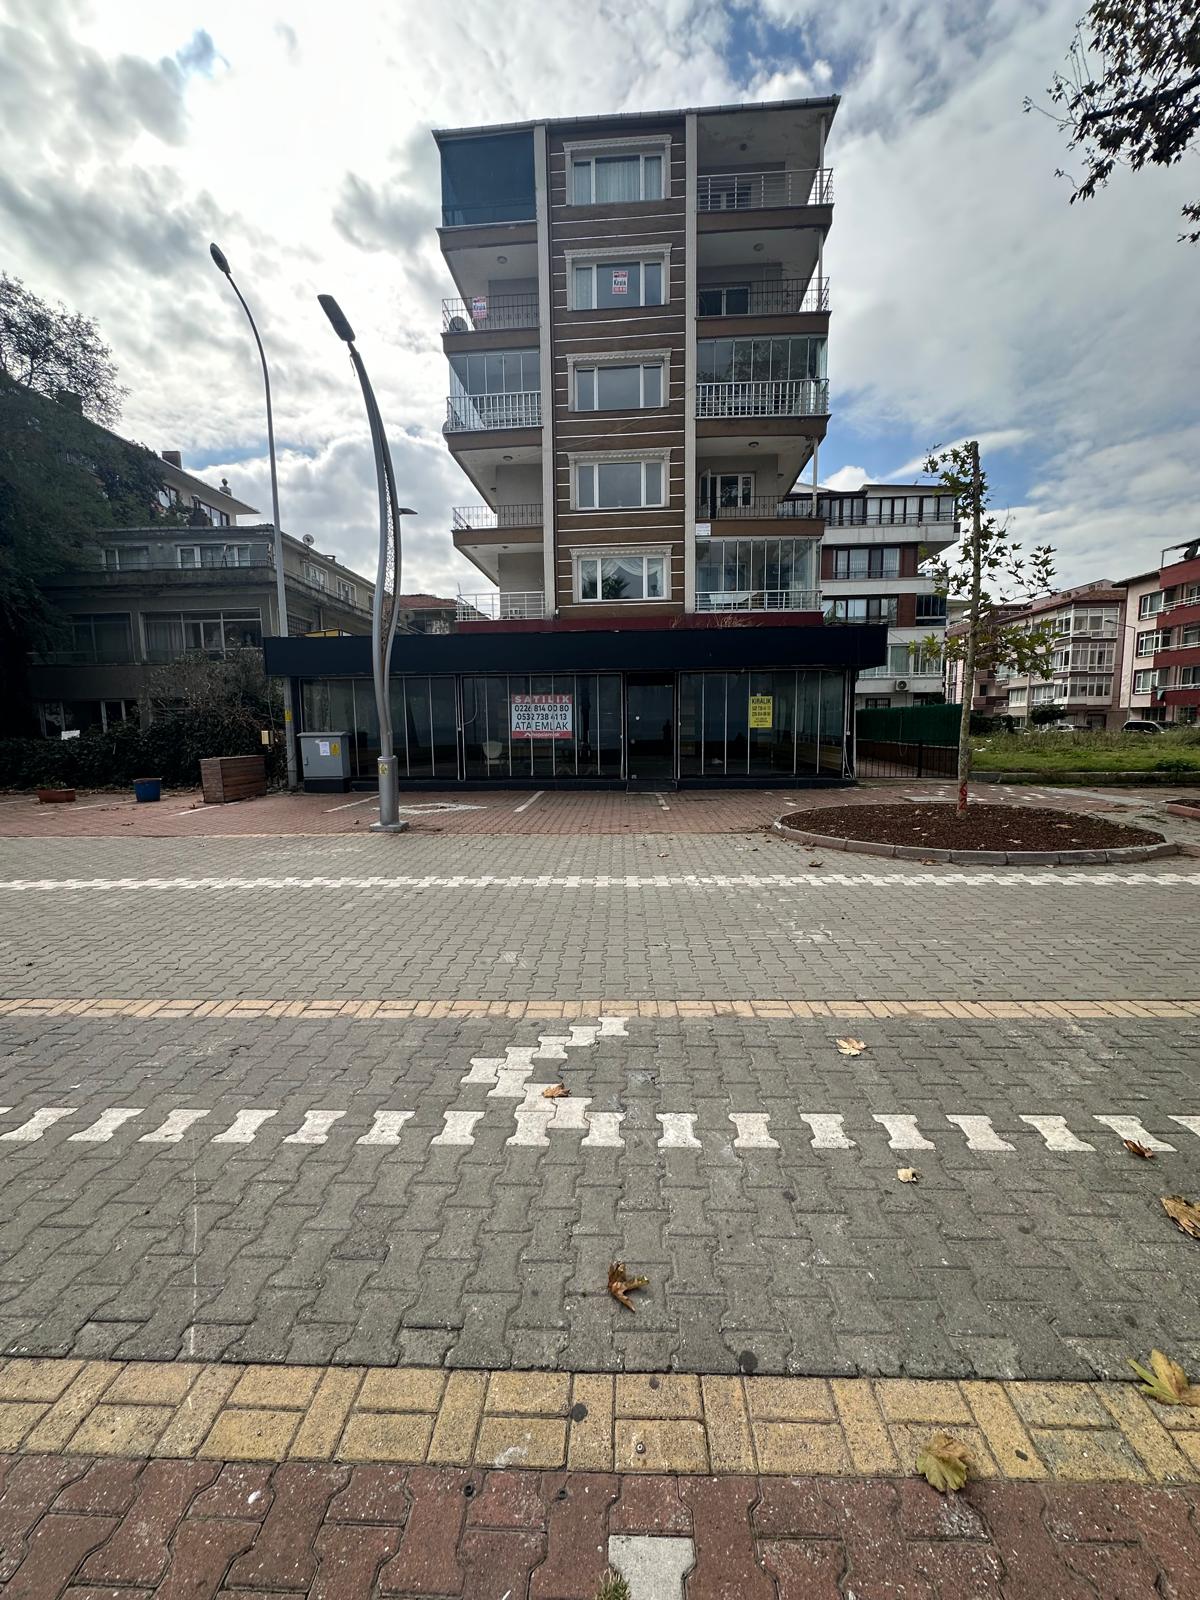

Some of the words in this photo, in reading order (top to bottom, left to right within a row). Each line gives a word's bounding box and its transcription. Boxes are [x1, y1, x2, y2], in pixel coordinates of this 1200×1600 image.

[514, 704, 532, 712] 0226
[534, 704, 546, 712] 814
[547, 704, 558, 712] 00
[559, 704, 570, 712] 80
[516, 712, 534, 720] 0532
[536, 712, 549, 721] 738
[559, 713, 568, 721] 13
[514, 721, 532, 731] ATA
[534, 721, 569, 731] EMLAK
